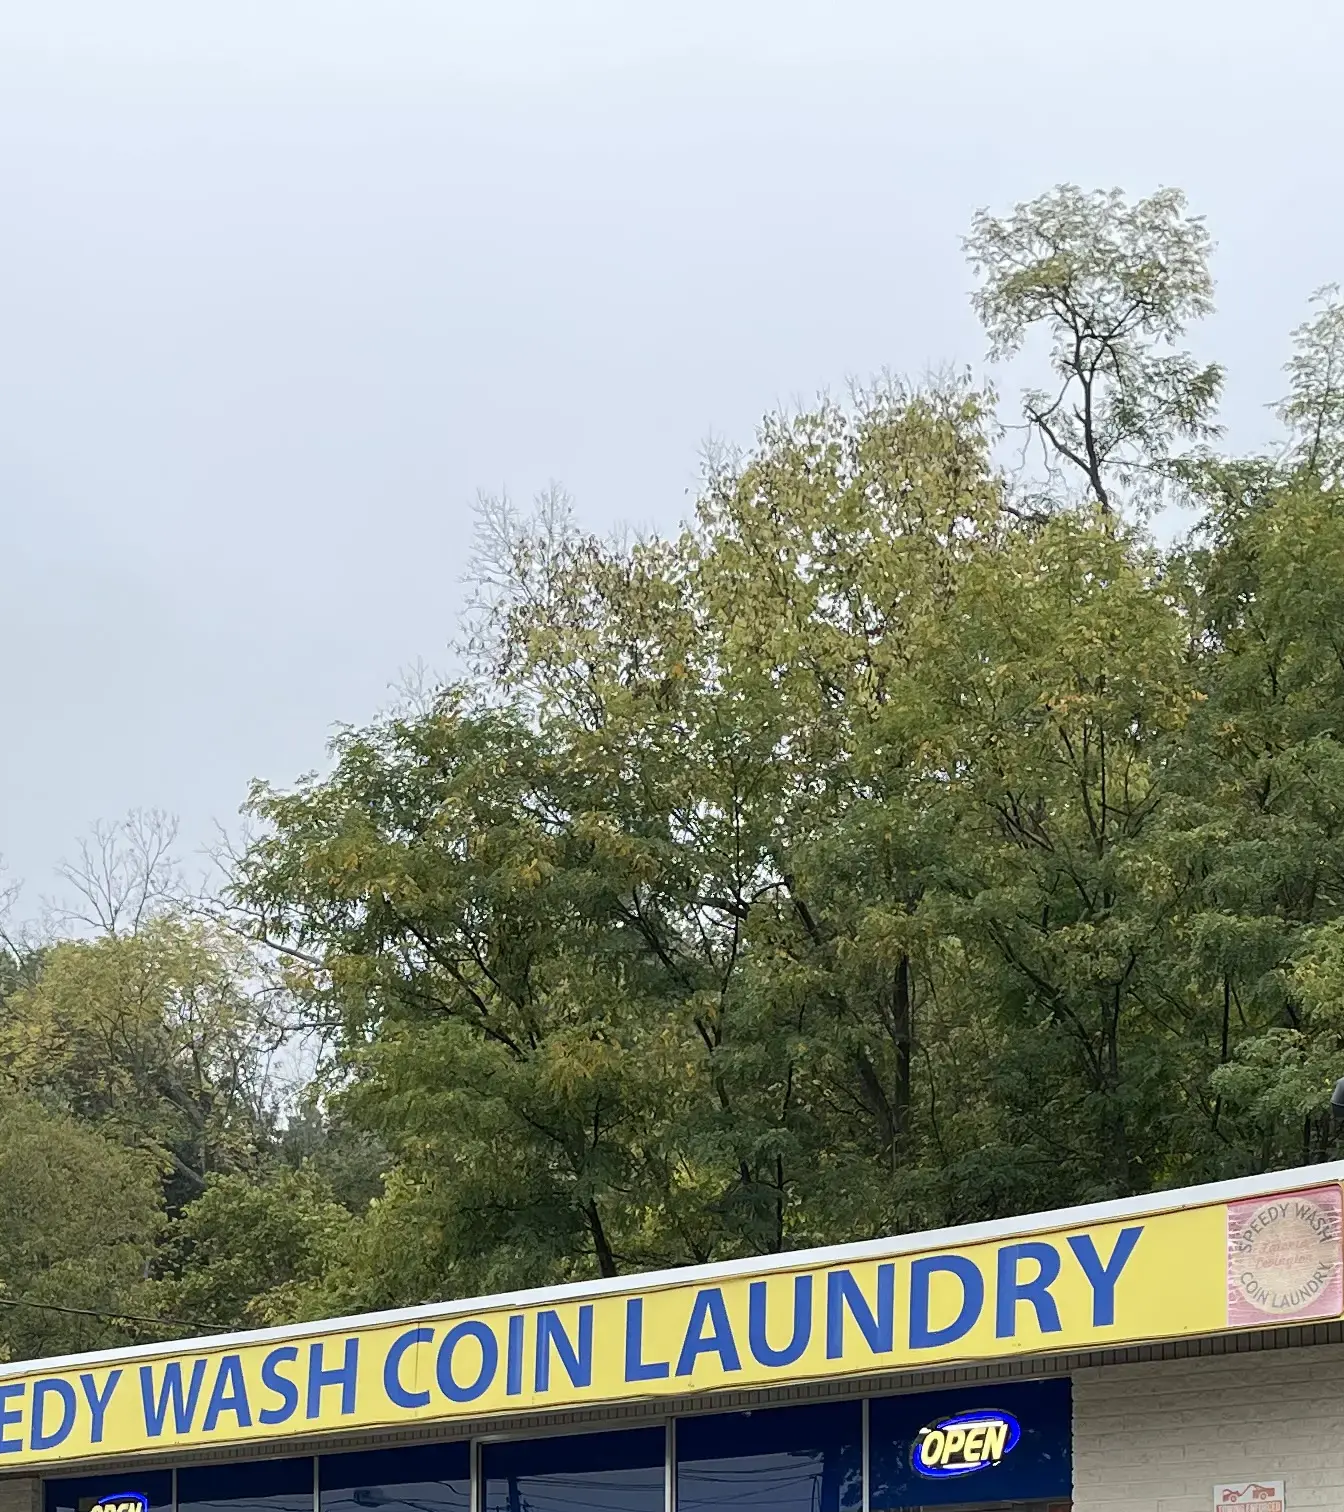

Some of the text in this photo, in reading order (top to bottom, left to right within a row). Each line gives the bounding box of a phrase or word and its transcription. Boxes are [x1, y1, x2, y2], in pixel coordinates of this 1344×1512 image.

[1238, 1202, 1333, 1254] SPEEDY WASH
[1240, 1262, 1333, 1308] COIN LAUNDRY
[140, 1338, 359, 1438] WASH
[384, 1315, 593, 1408] COIN
[625, 1227, 1143, 1382] LAUNDRY
[920, 1423, 1008, 1466] OPEN
